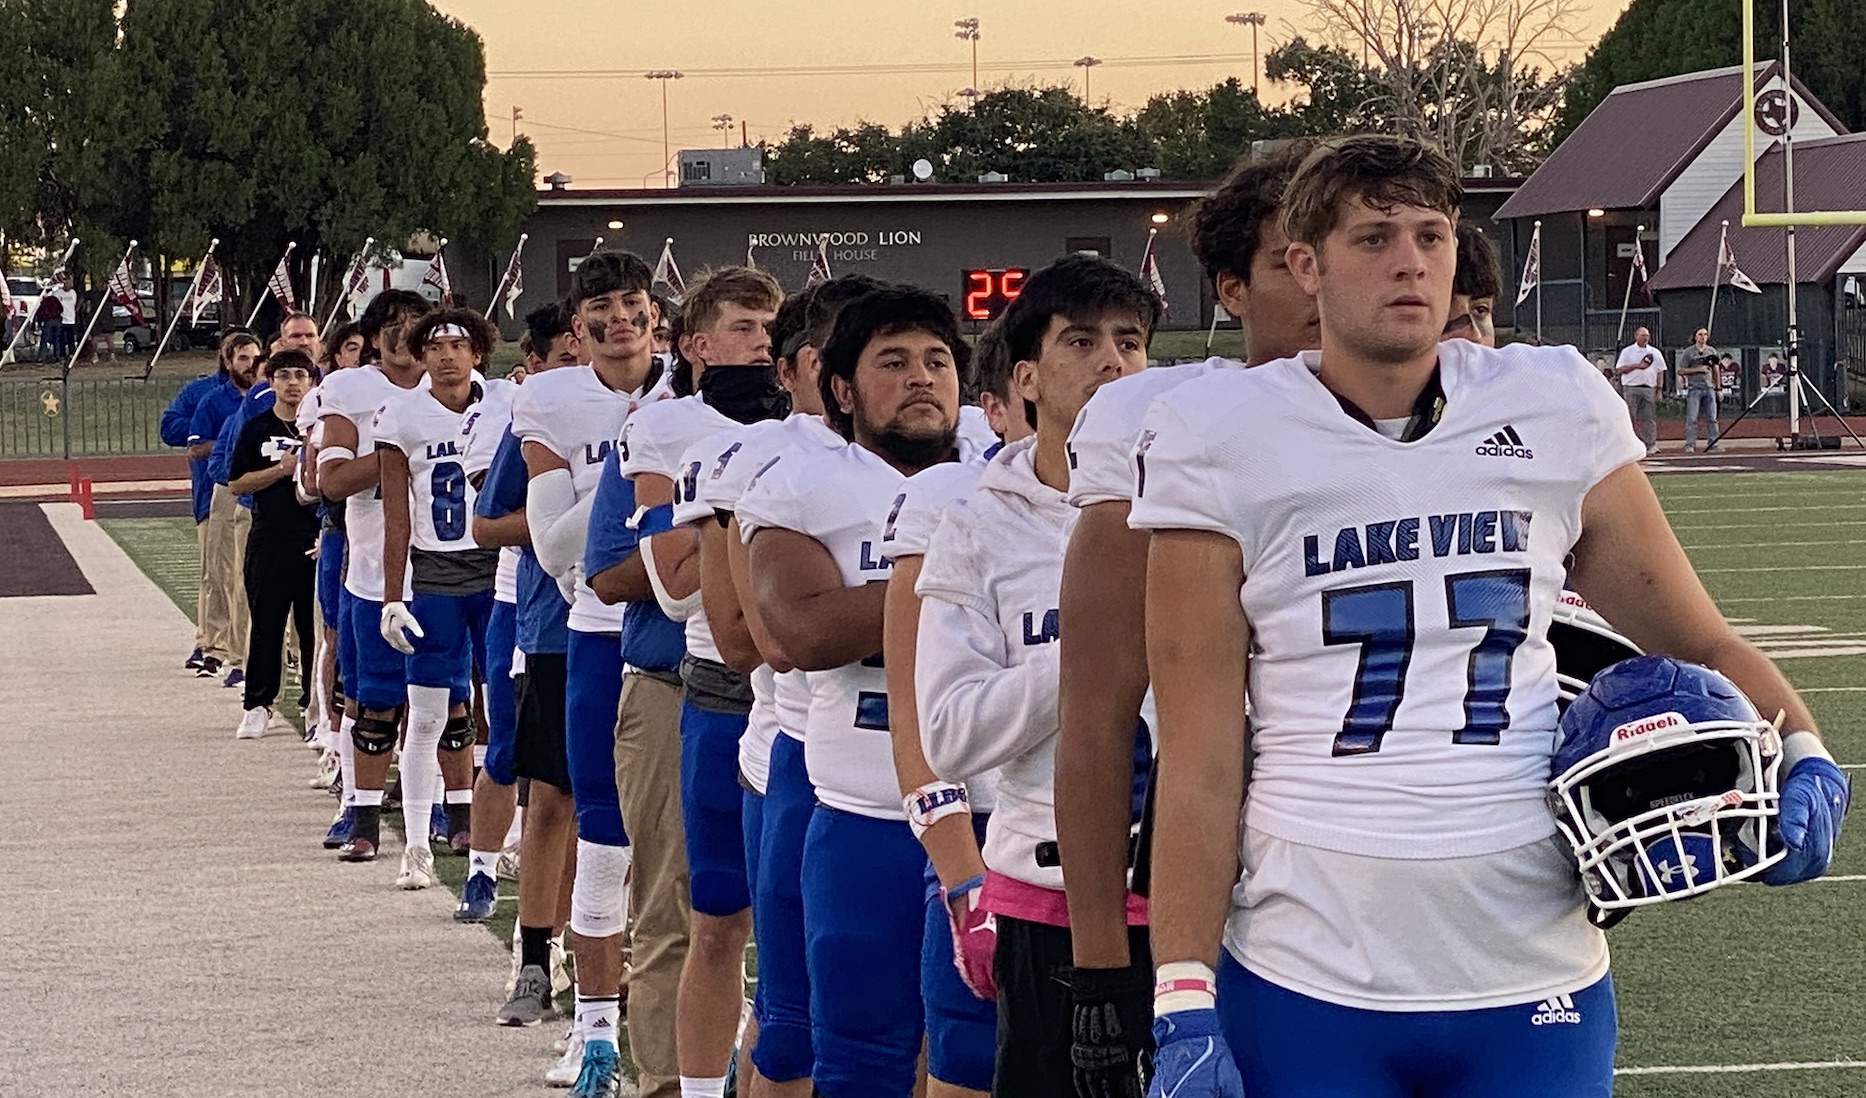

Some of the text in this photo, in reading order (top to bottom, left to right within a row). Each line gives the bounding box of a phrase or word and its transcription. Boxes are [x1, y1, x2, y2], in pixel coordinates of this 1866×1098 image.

[879, 230, 922, 246] LION
[793, 249, 878, 261] FIEL HOUSE
[427, 441, 462, 460] LAK
[1475, 444, 1534, 460] adidas
[431, 461, 466, 541] 8
[1304, 510, 1532, 577] LAKE VIEW
[1322, 567, 1532, 757] 77
[1531, 1009, 1581, 1026] adidas
